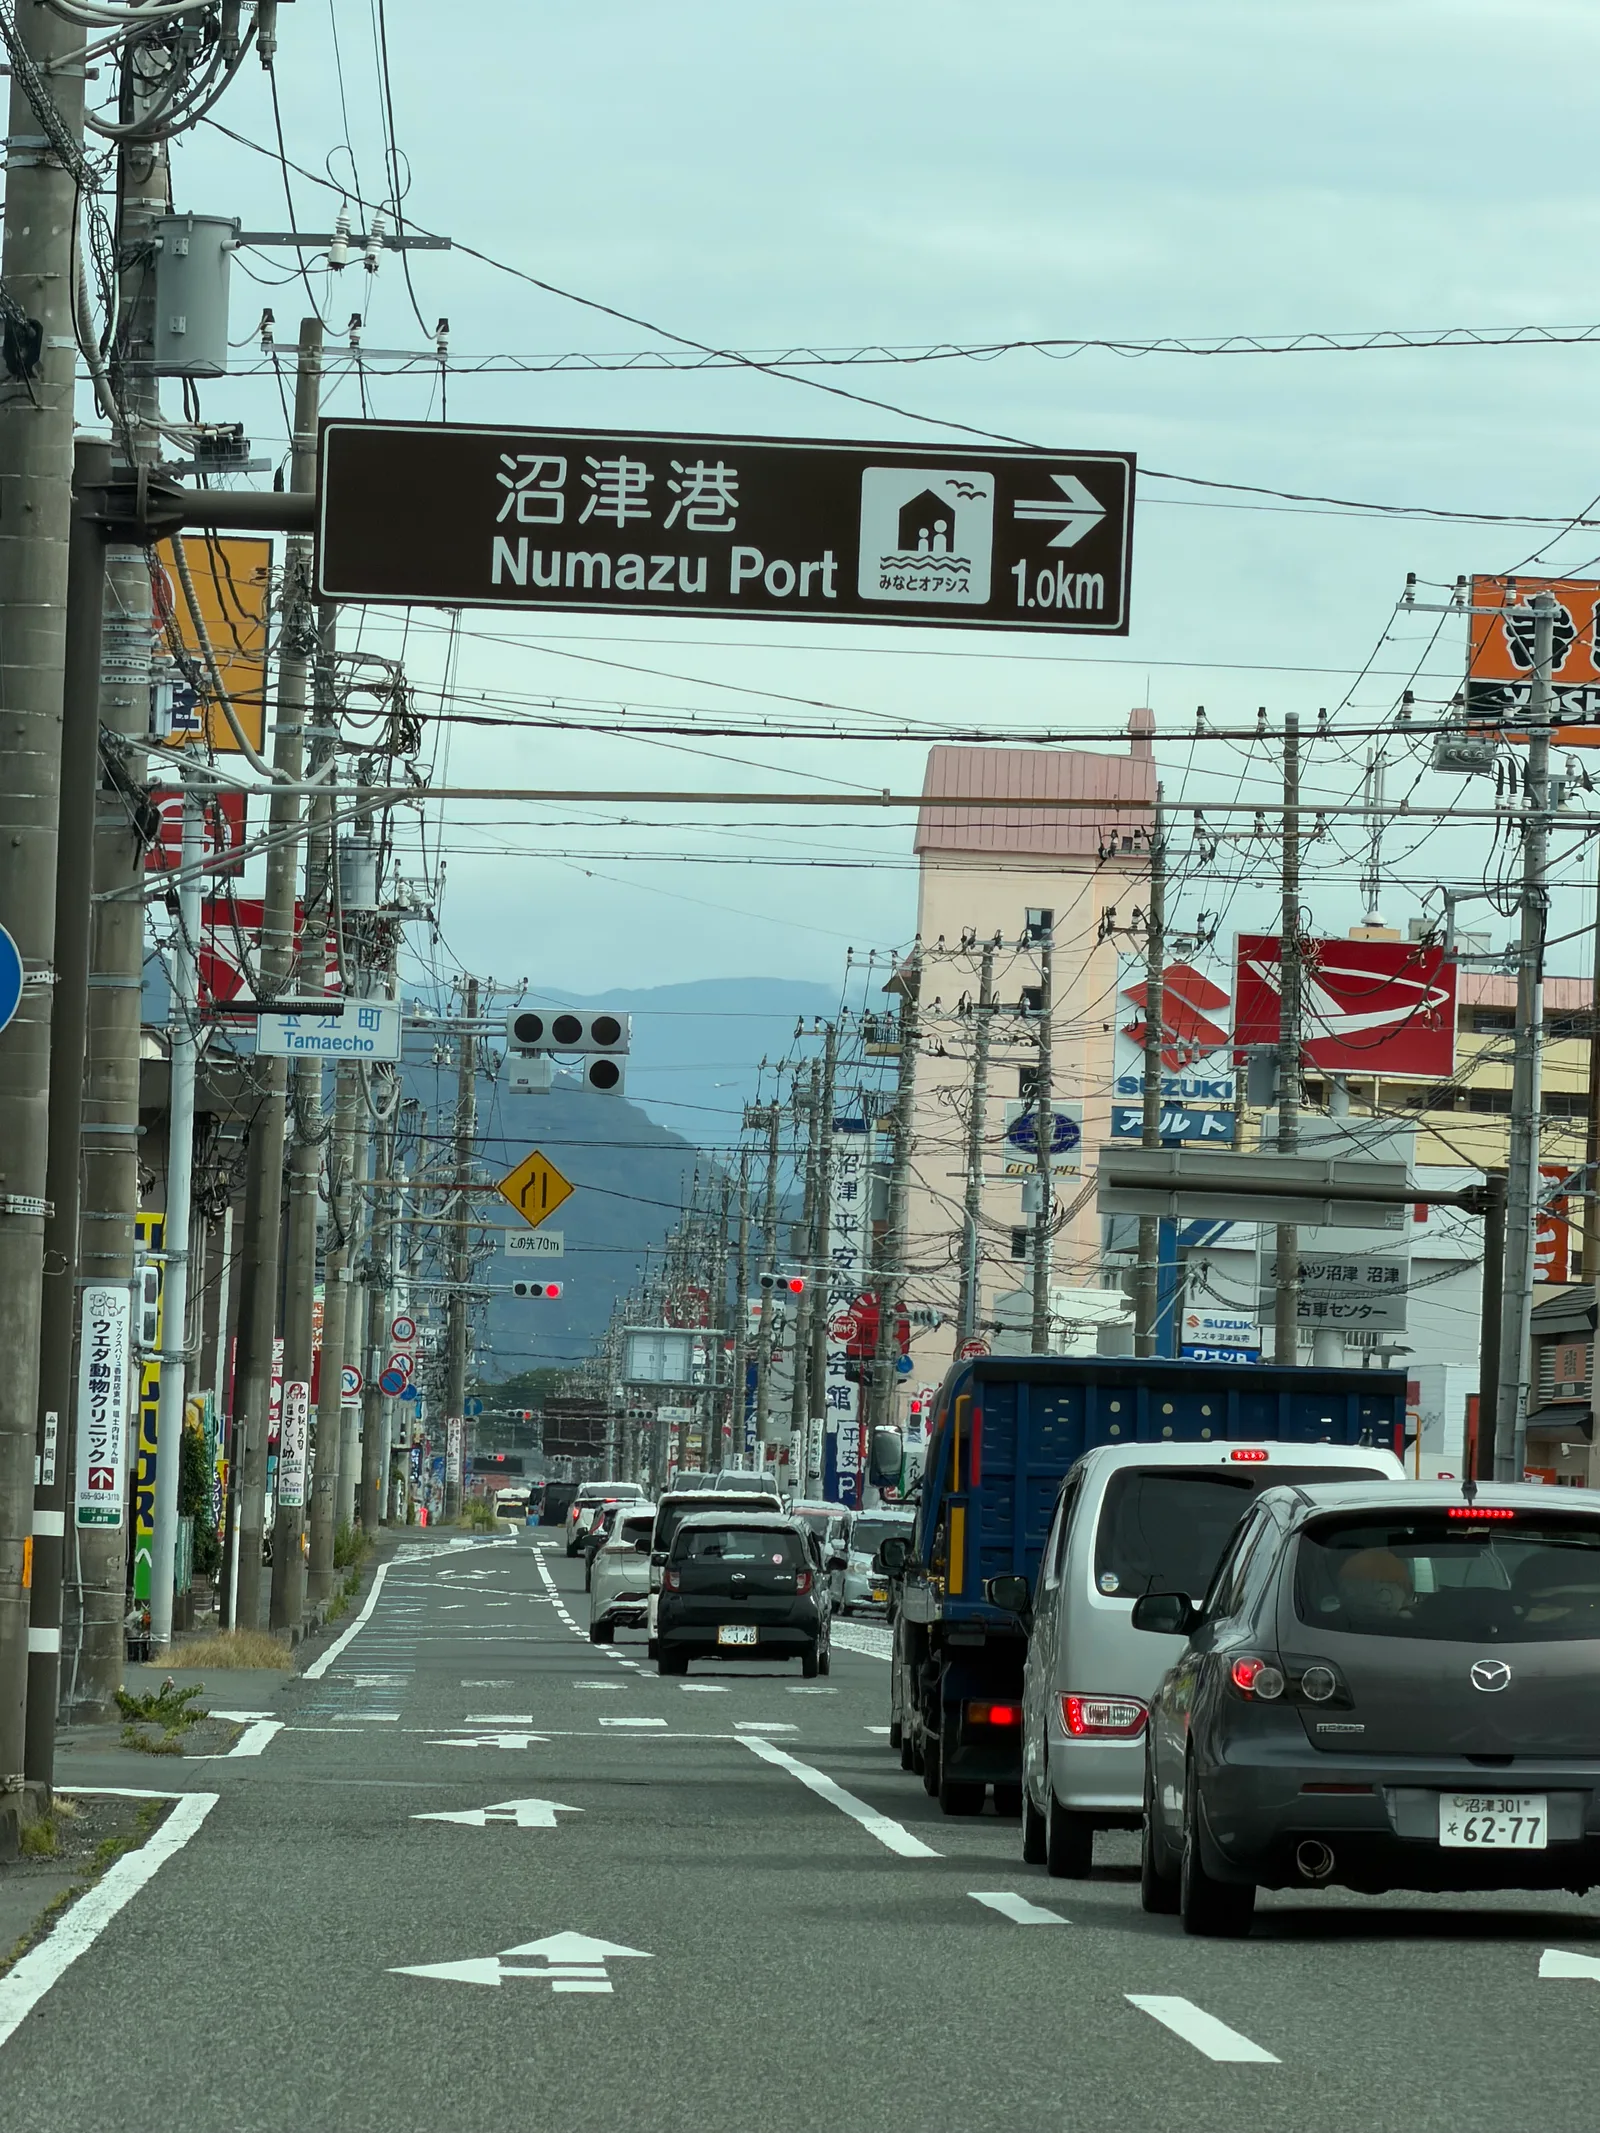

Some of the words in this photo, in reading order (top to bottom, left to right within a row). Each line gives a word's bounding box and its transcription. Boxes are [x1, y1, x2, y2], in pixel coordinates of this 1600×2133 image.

[495, 453, 739, 532] 沼津港
[491, 536, 708, 594] Numazu
[729, 546, 838, 598] Port
[879, 574, 970, 593] みなとオアシス
[1010, 558, 1105, 610] 1.0km
[284, 1031, 374, 1052] Tamaecho
[1366, 1266, 1399, 1283] 沼津
[1203, 1318, 1256, 1330] SUZUK
[88, 1319, 112, 1463] ウエダ動物クリニック
[842, 1426, 860, 1467] 平安
[1463, 1816, 1541, 1844] 62-77
